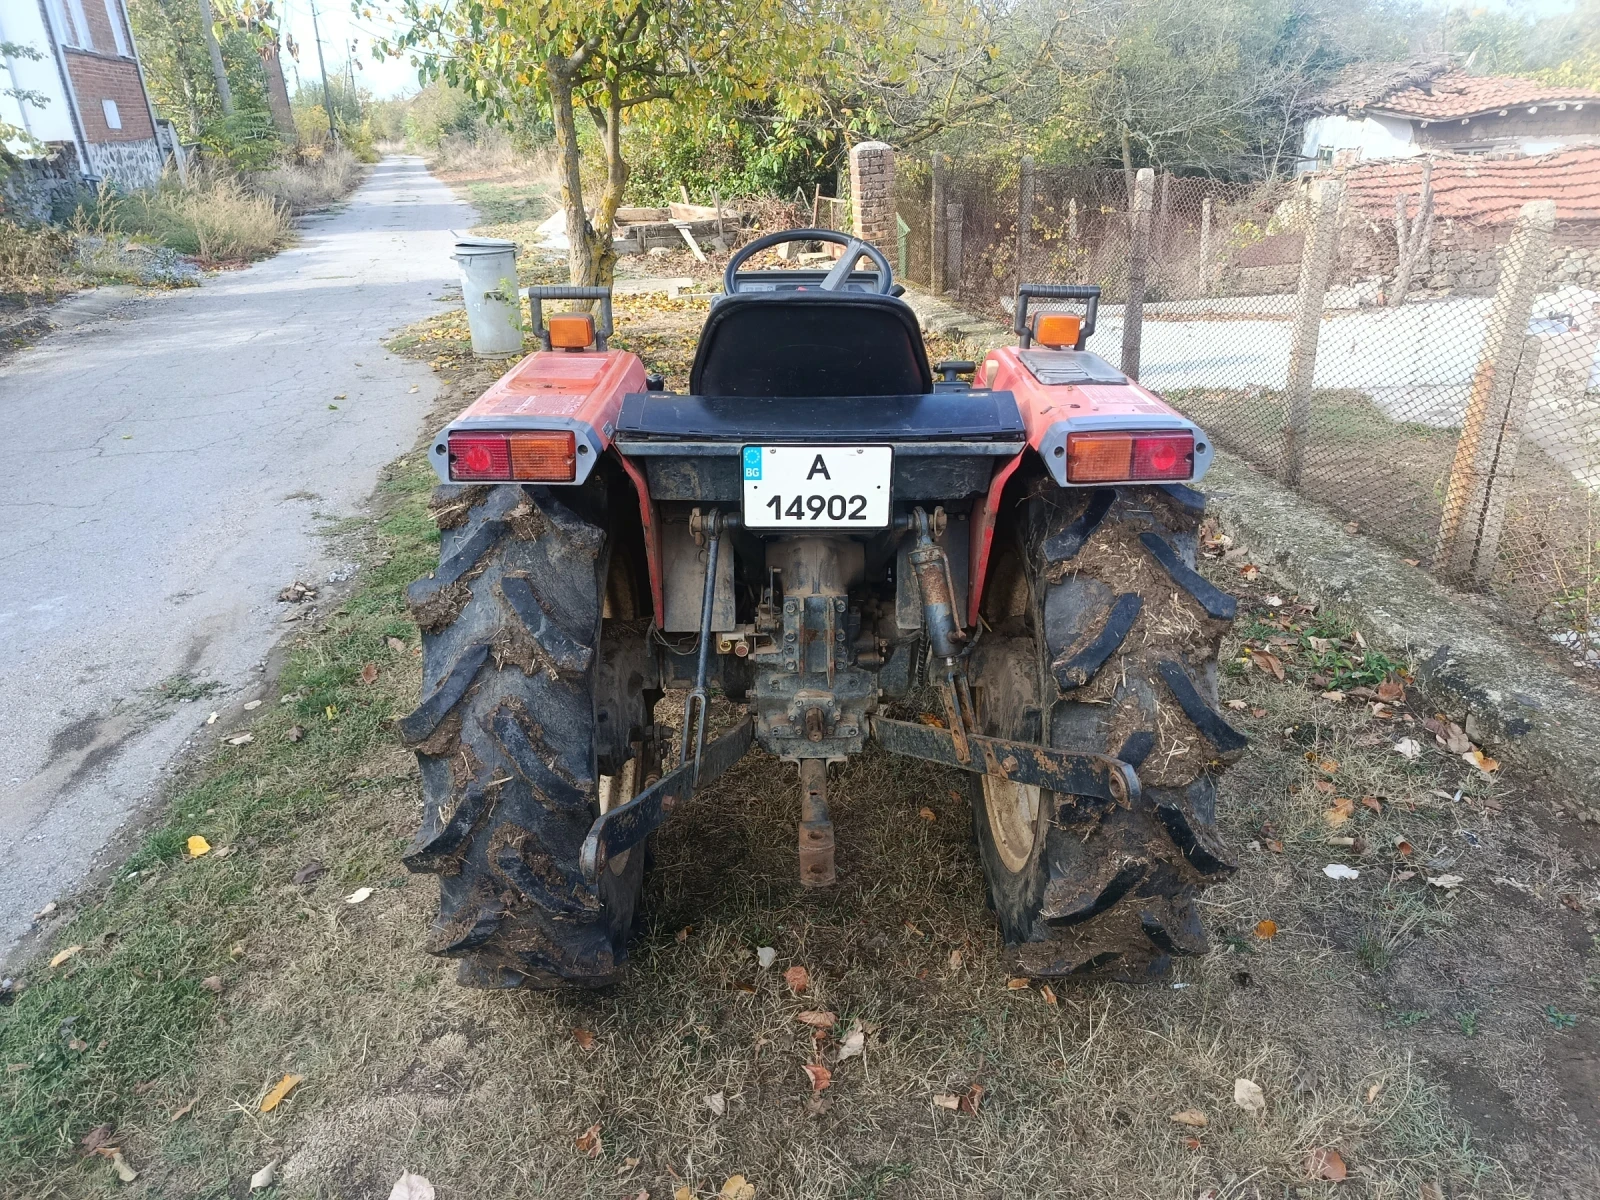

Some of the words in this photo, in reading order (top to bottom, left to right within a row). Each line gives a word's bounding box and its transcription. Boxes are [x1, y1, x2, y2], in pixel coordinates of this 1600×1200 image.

[745, 467, 760, 477] BG
[806, 454, 831, 480] A
[766, 494, 867, 520] 14902
